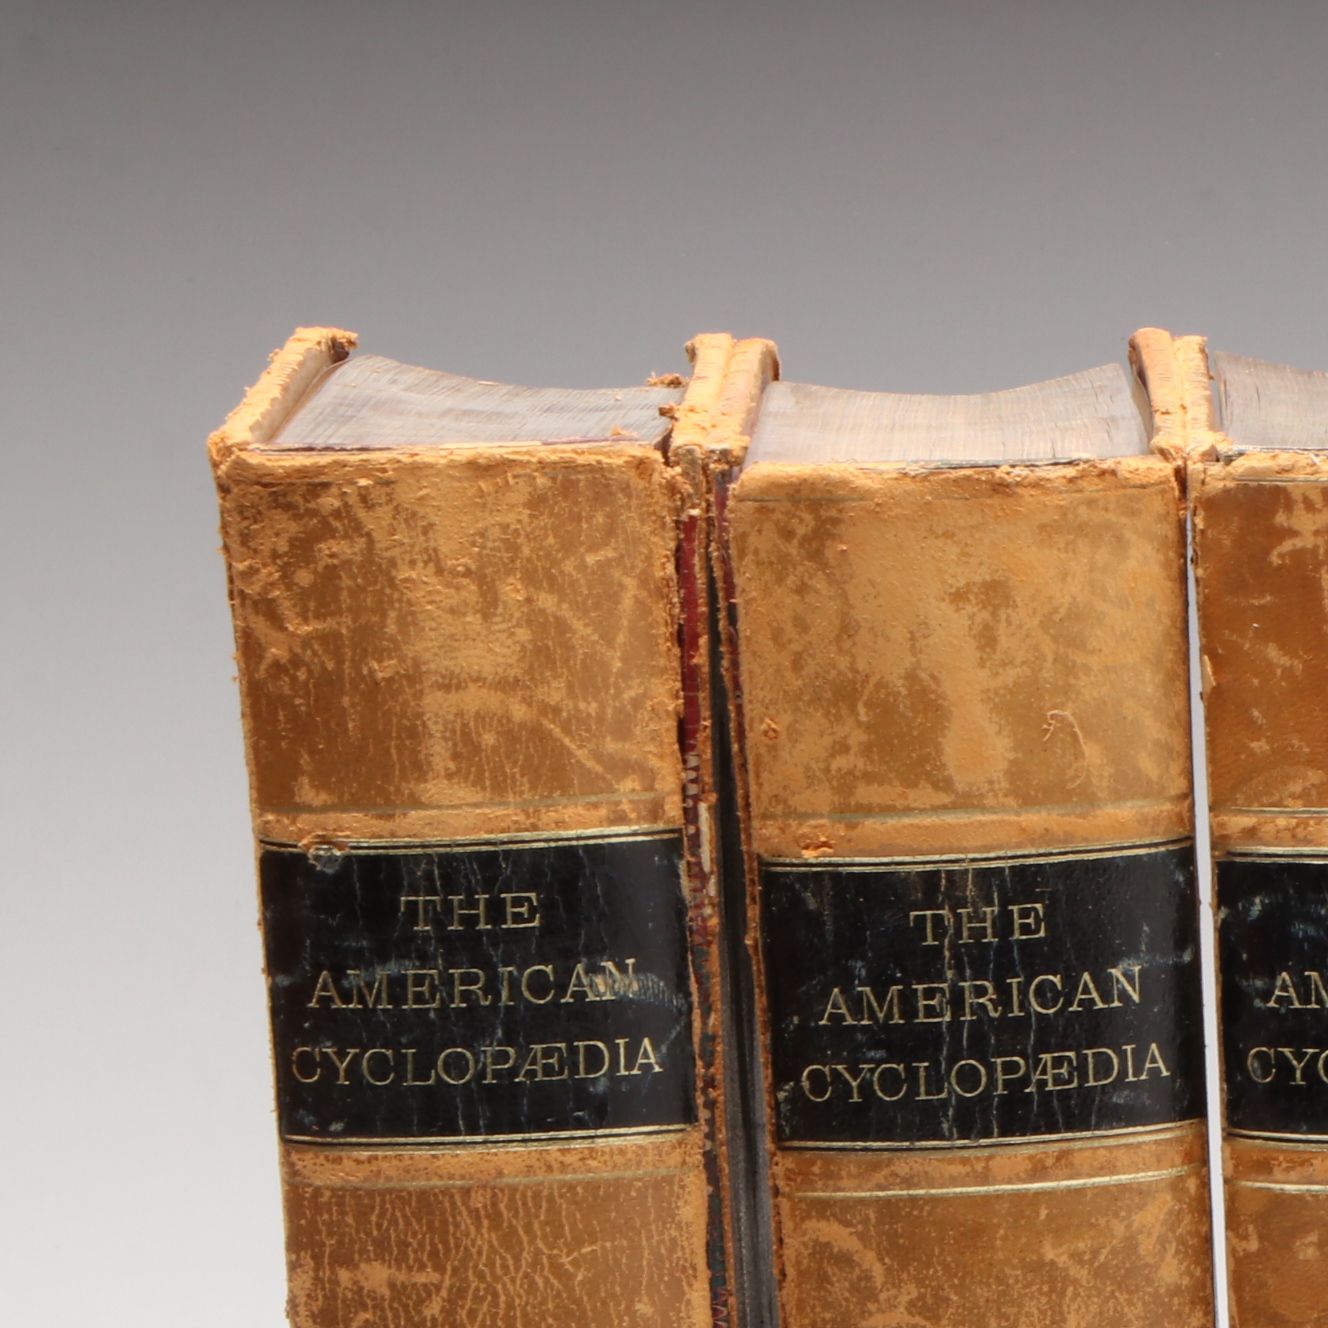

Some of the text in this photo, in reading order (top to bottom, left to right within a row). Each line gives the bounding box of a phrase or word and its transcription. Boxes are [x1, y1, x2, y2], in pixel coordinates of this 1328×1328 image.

[400, 892, 541, 931] THE
[910, 903, 1046, 946] THE
[307, 958, 641, 1009] AMERICAN
[818, 966, 1142, 1026] AMERICAN
